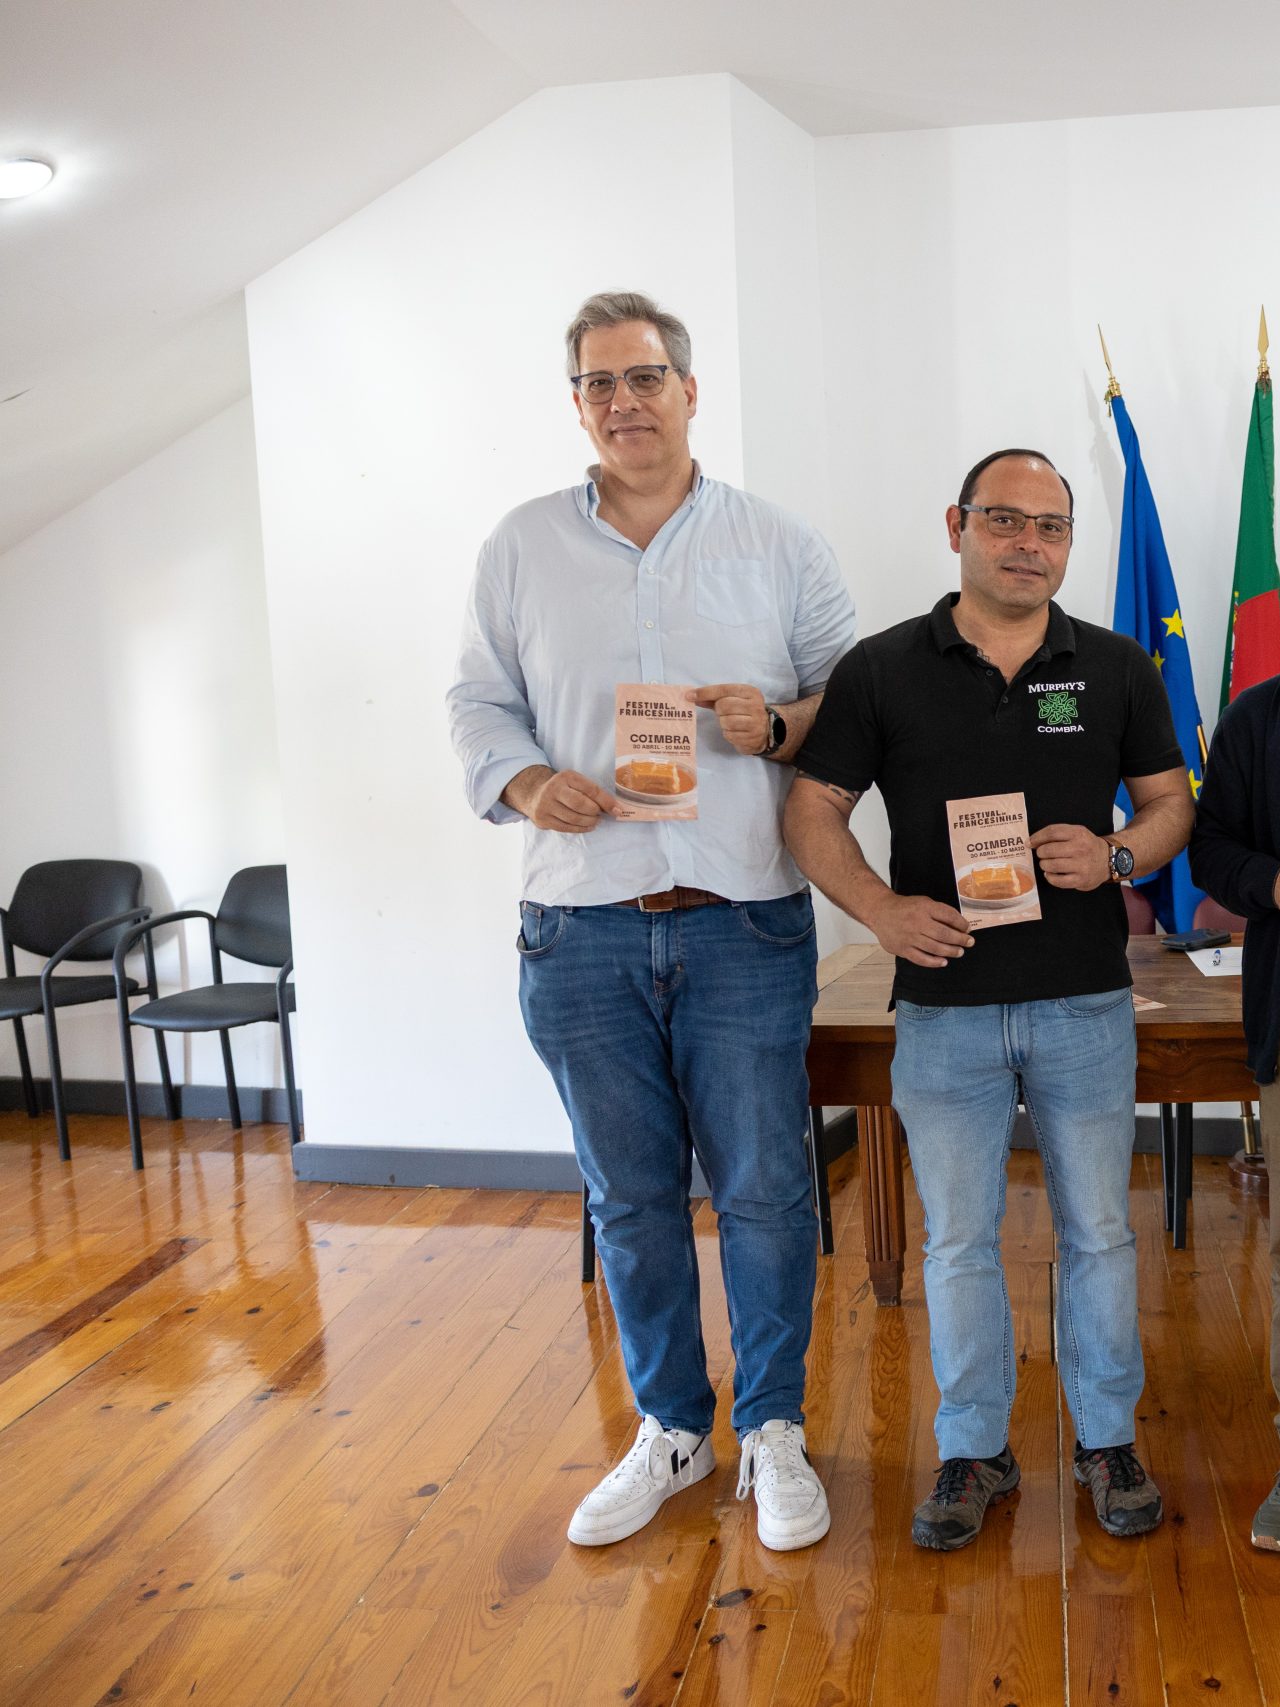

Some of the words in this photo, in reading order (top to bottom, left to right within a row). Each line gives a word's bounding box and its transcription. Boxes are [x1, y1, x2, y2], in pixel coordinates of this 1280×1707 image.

[1028, 681, 1086, 693] MURPHY'S
[626, 701, 670, 709] FESTIVAL
[620, 708, 693, 718] FRANCESINHAS
[1037, 725, 1085, 733] COIMBRA
[630, 734, 690, 744] COIMBRA
[959, 810, 1001, 821] FESTIVAL
[953, 813, 1023, 829] FRANCESINHAS
[967, 836, 1024, 852] COIMBRA
